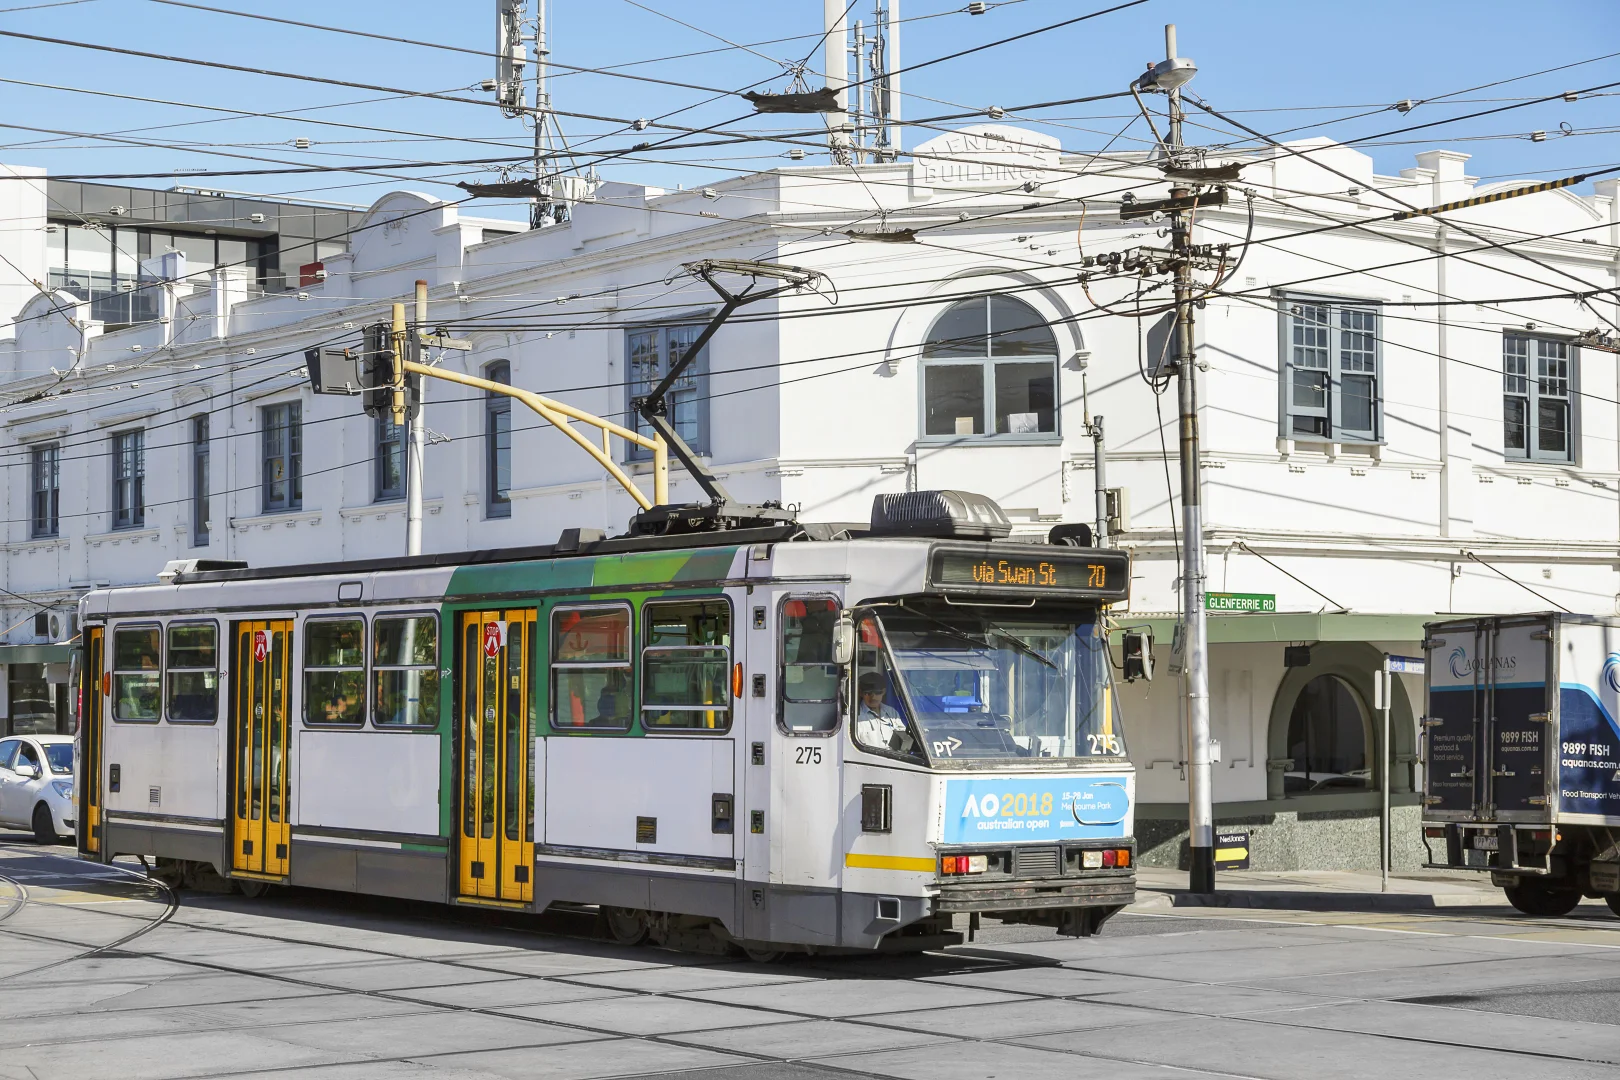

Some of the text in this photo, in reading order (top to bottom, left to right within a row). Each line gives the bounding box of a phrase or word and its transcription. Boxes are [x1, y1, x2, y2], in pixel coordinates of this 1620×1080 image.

[925, 163, 1048, 184] BUILDINGS
[973, 561, 1106, 587] via Swan St 70
[1209, 597, 1275, 611] GLENFERRIE RD
[486, 626, 499, 636] STOP
[1464, 656, 1517, 672] AQUANAS
[1086, 733, 1121, 755] 275
[1433, 734, 1456, 742] Premium
[1501, 731, 1539, 743] 9899 FISH
[795, 746, 822, 765] 275
[1562, 742, 1610, 756] 9899 FISH
[1561, 759, 1620, 769] aquanas.com.
[1082, 791, 1094, 800] Jan
[1562, 789, 1579, 798] Food
[1579, 790, 1607, 801] Transport
[1097, 801, 1112, 810] Park
[977, 818, 1025, 830] australian
[1026, 820, 1049, 832] open
